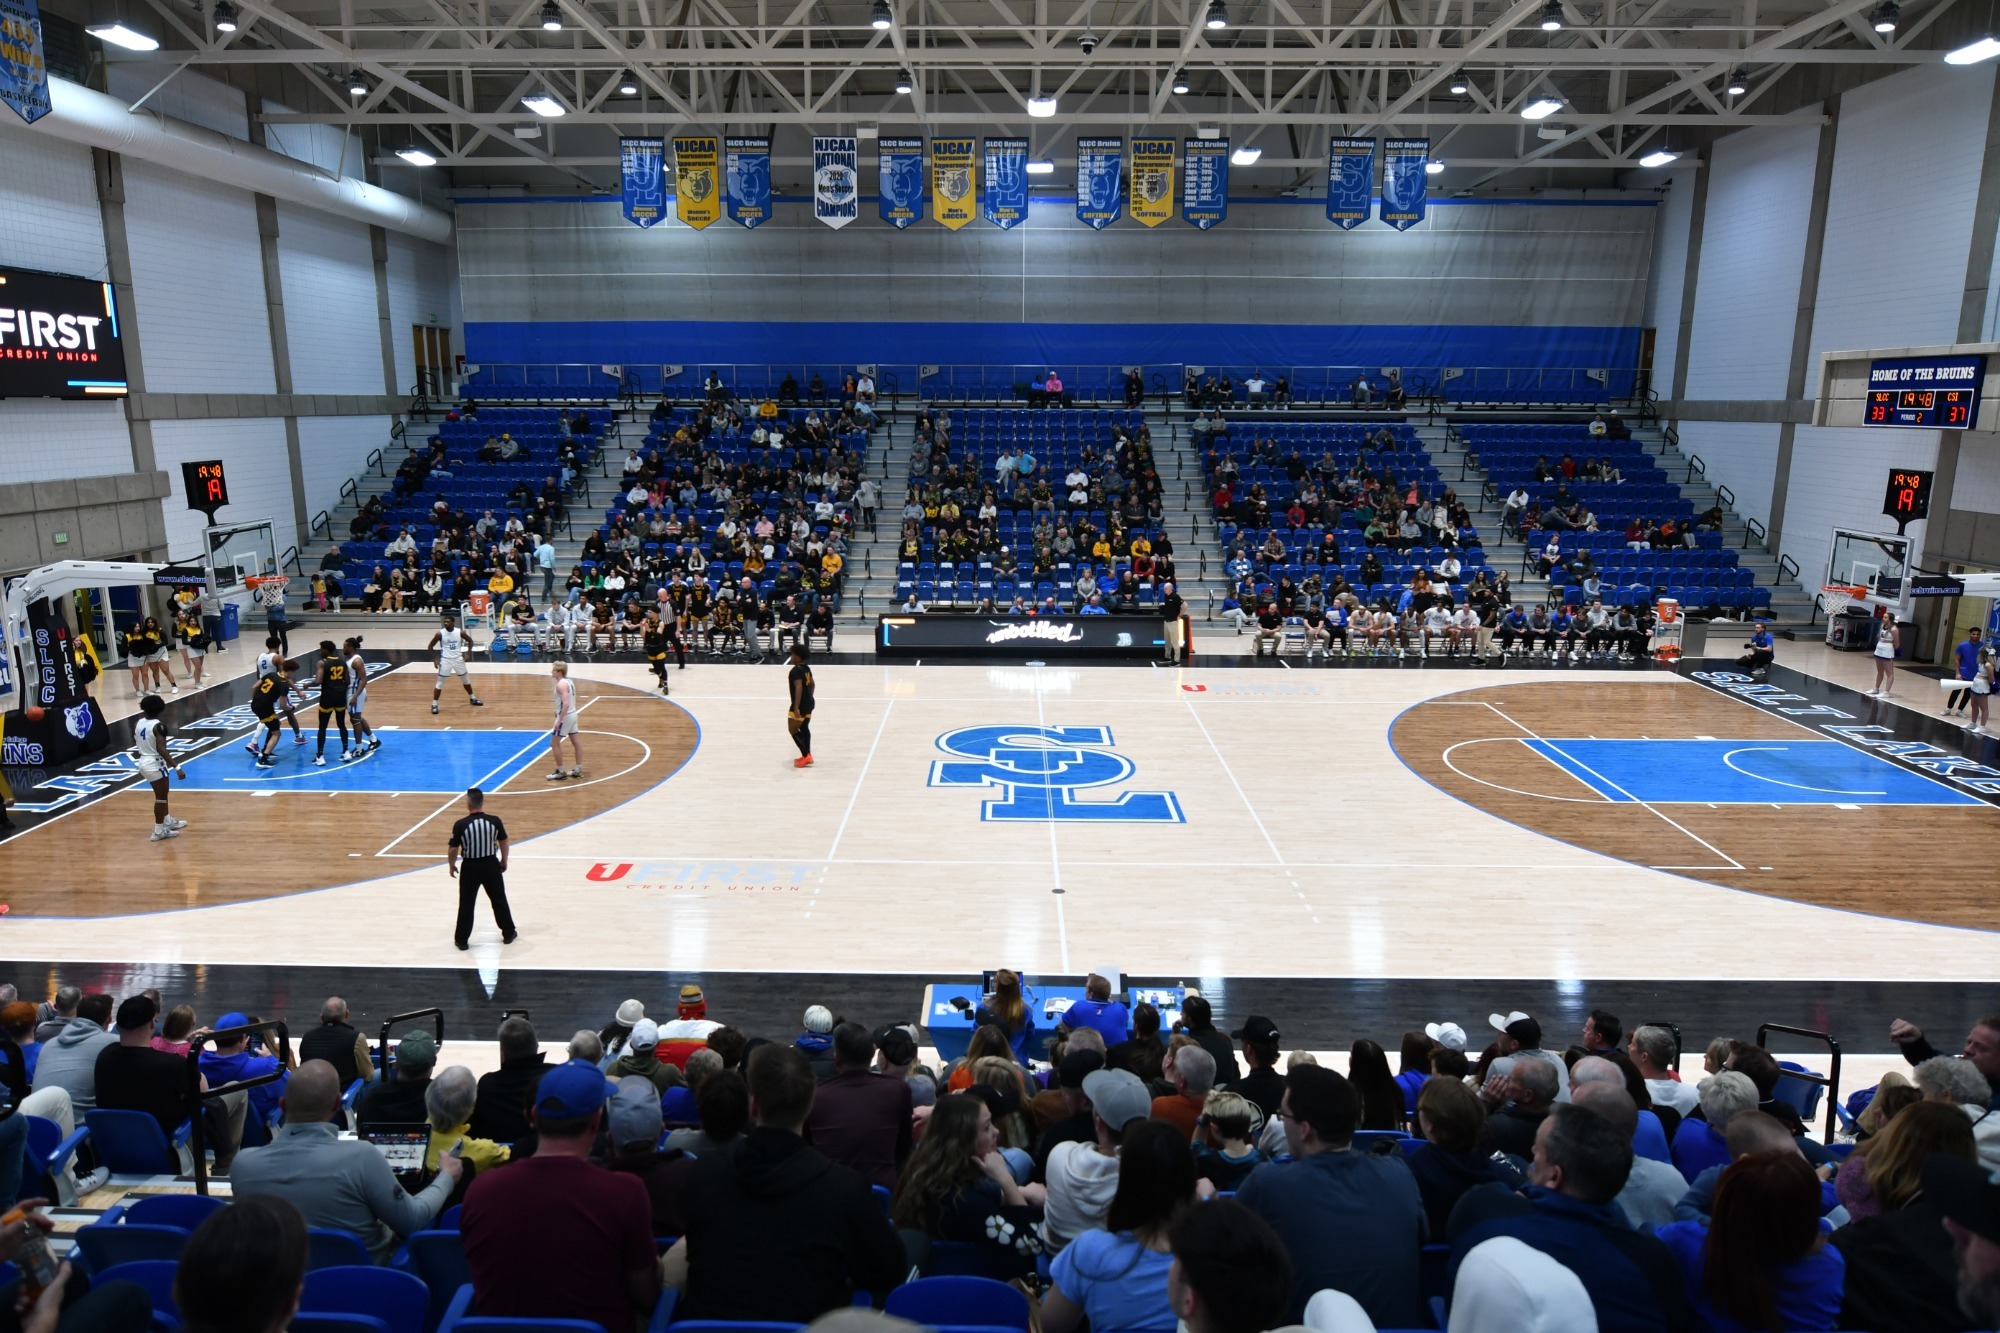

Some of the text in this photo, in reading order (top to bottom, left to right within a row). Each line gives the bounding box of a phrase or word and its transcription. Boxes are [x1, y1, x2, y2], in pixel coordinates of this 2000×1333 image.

[675, 140, 716, 152] NJCAA
[815, 139, 855, 151] NJCAA
[933, 142, 974, 154] NJCAA
[1133, 142, 1174, 154] NJCAA
[815, 152, 856, 173] NATIONAL
[829, 171, 843, 181] 2020
[818, 184, 854, 193] Men's Soccer
[816, 197, 856, 217] CHAMPIONS
[57, 352, 98, 362] UNION
[613, 366, 619, 375] A
[665, 366, 672, 375] B
[868, 367, 874, 375] B
[921, 367, 928, 375] C
[1446, 370, 1452, 378] E
[1871, 366, 1975, 381] HOME OF THE BRUINS
[1876, 393, 1890, 402] SLCC
[1947, 392, 1959, 402] CSI
[1872, 406, 1885, 420] 33
[1916, 411, 1923, 423] 2
[1949, 406, 1966, 422] 37
[208, 479, 222, 501] 19
[1898, 489, 1914, 511] 19
[24, 587, 45, 605] SPALDING
[36, 628, 56, 704] SLCC
[261, 659, 268, 670] 2
[330, 665, 344, 681] 32
[1691, 671, 1857, 719] SALT
[139, 727, 147, 740] 4
